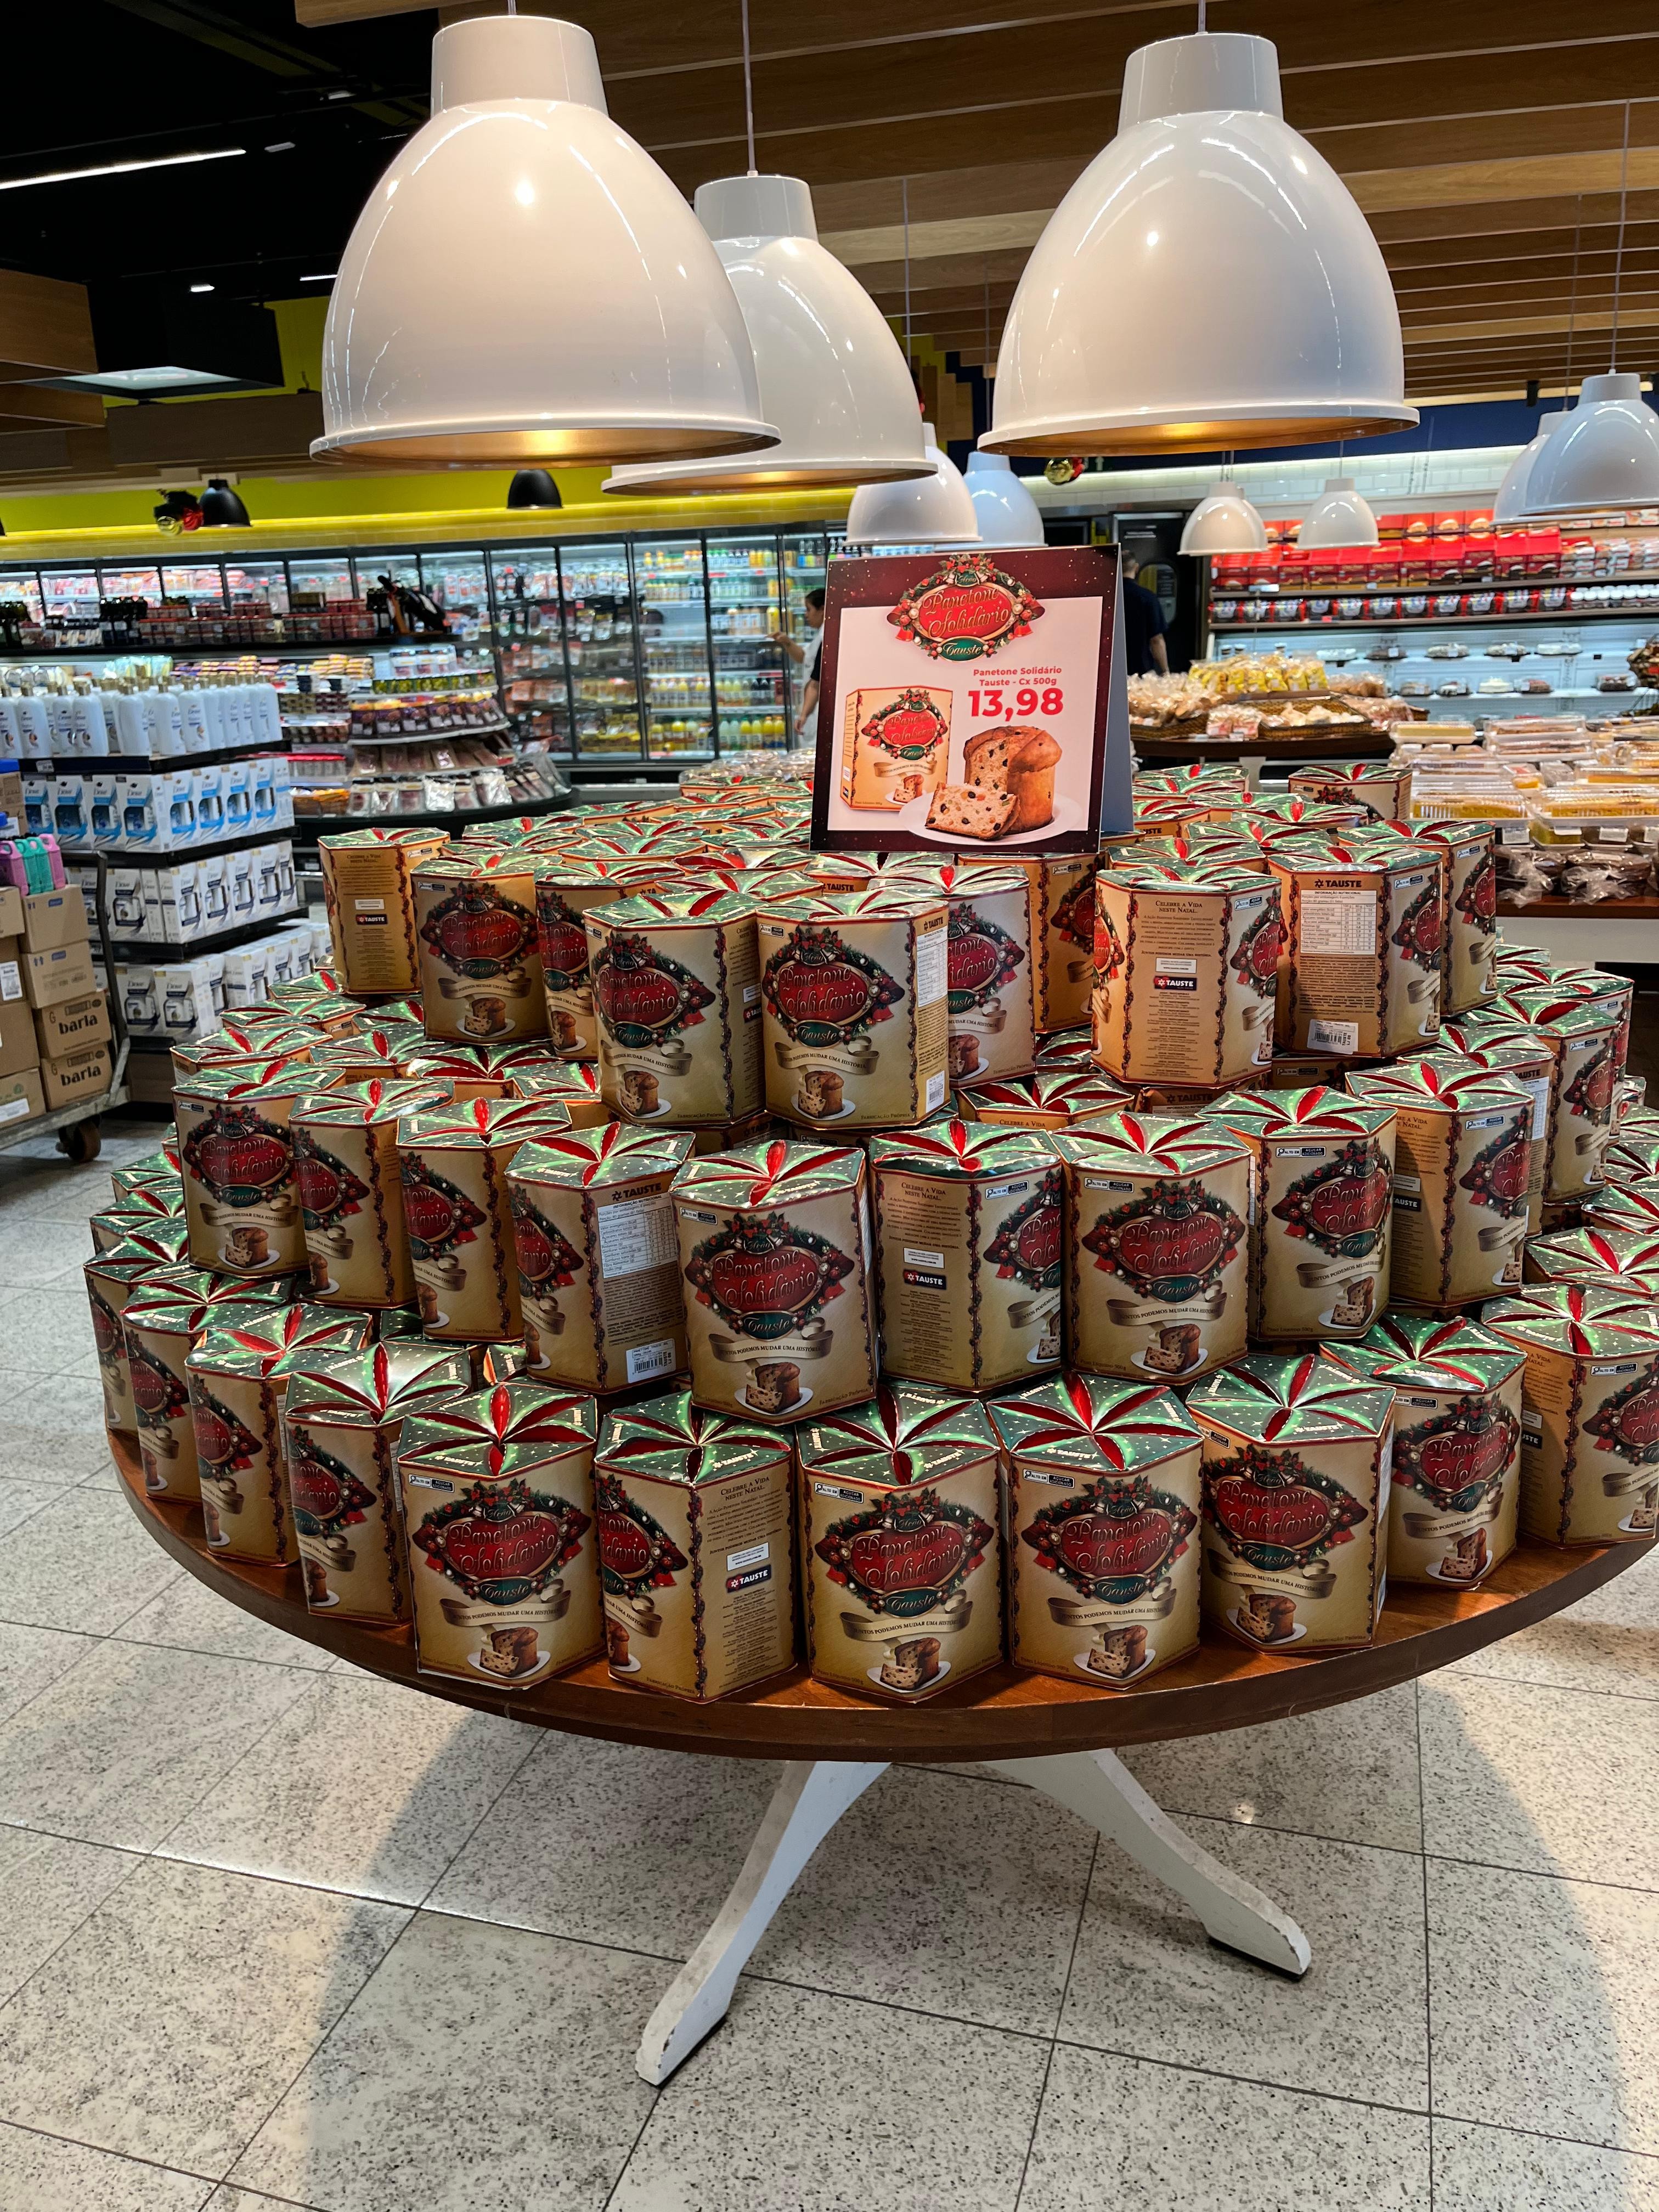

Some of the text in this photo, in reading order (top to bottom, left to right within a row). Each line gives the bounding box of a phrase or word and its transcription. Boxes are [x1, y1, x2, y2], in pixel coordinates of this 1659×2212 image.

[923, 588, 1000, 614] Panetone
[929, 606, 1009, 639] Solidário
[943, 642, 982, 656] Tauste
[973, 666, 1062, 676] Panetone Solidário
[979, 679, 1010, 687] Tauste
[1033, 677, 1057, 686] 500g
[968, 688, 1063, 721] 13,98
[928, 917, 943, 928] TAUSTE
[600, 970, 661, 992] Panetone
[780, 967, 851, 990] Panetone
[604, 991, 675, 1017] Solidário
[786, 988, 865, 1017] Solidário
[617, 1026, 650, 1042] Tauste
[798, 1025, 837, 1041] Tauste
[1031, 1119, 1045, 1127] VIDA
[202, 1136, 270, 1160] Panetone
[210, 1155, 284, 1181] Solidário
[623, 1183, 662, 1198] TAUSTE
[901, 1182, 924, 1192] CELEBRE
[1123, 1214, 1210, 1246] Panetone
[1134, 1235, 1220, 1273] Solidário
[715, 1249, 800, 1280] Panetone
[1330, 1266, 1356, 1279] PODEMOS
[915, 1275, 943, 1285] TAUSTE
[1153, 1280, 1197, 1296] Tauste
[725, 1270, 815, 1310] Solidário
[1035, 1297, 1056, 1313] PODEMOS
[1141, 1308, 1167, 1318] PODEMOS
[744, 1316, 791, 1333] Tauste
[737, 1346, 760, 1354] PODEMOS
[1537, 1353, 1551, 1363] VIDA
[721, 1452, 753, 1469] TAUSTE
[720, 1483, 747, 1496] CELEBRE
[754, 1476, 770, 1485] VIDA
[725, 1492, 743, 1501] NESTE
[1221, 1480, 1311, 1510] Panetone
[449, 1514, 541, 1548] Panetone
[1065, 1513, 1158, 1545] Panetone
[1228, 1510, 1325, 1536] Solidário
[1439, 1519, 1466, 1531] PODEMOS
[854, 1522, 949, 1561] Panetone
[460, 1532, 555, 1577] Solidário
[1075, 1531, 1169, 1574] Solidário
[1244, 1544, 1293, 1565] Tauste
[865, 1541, 962, 1588] Solidário
[740, 1570, 768, 1584] TAUSTE
[1258, 1576, 1279, 1584] MUDAR
[481, 1585, 529, 1599] Tauste
[1097, 1581, 1143, 1597] Tauste
[887, 1595, 935, 1611] Tauste
[472, 1611, 496, 1620] PODEMOS
[1084, 1610, 1112, 1618] PODEMOS
[874, 1624, 902, 1634] PODEMOS
